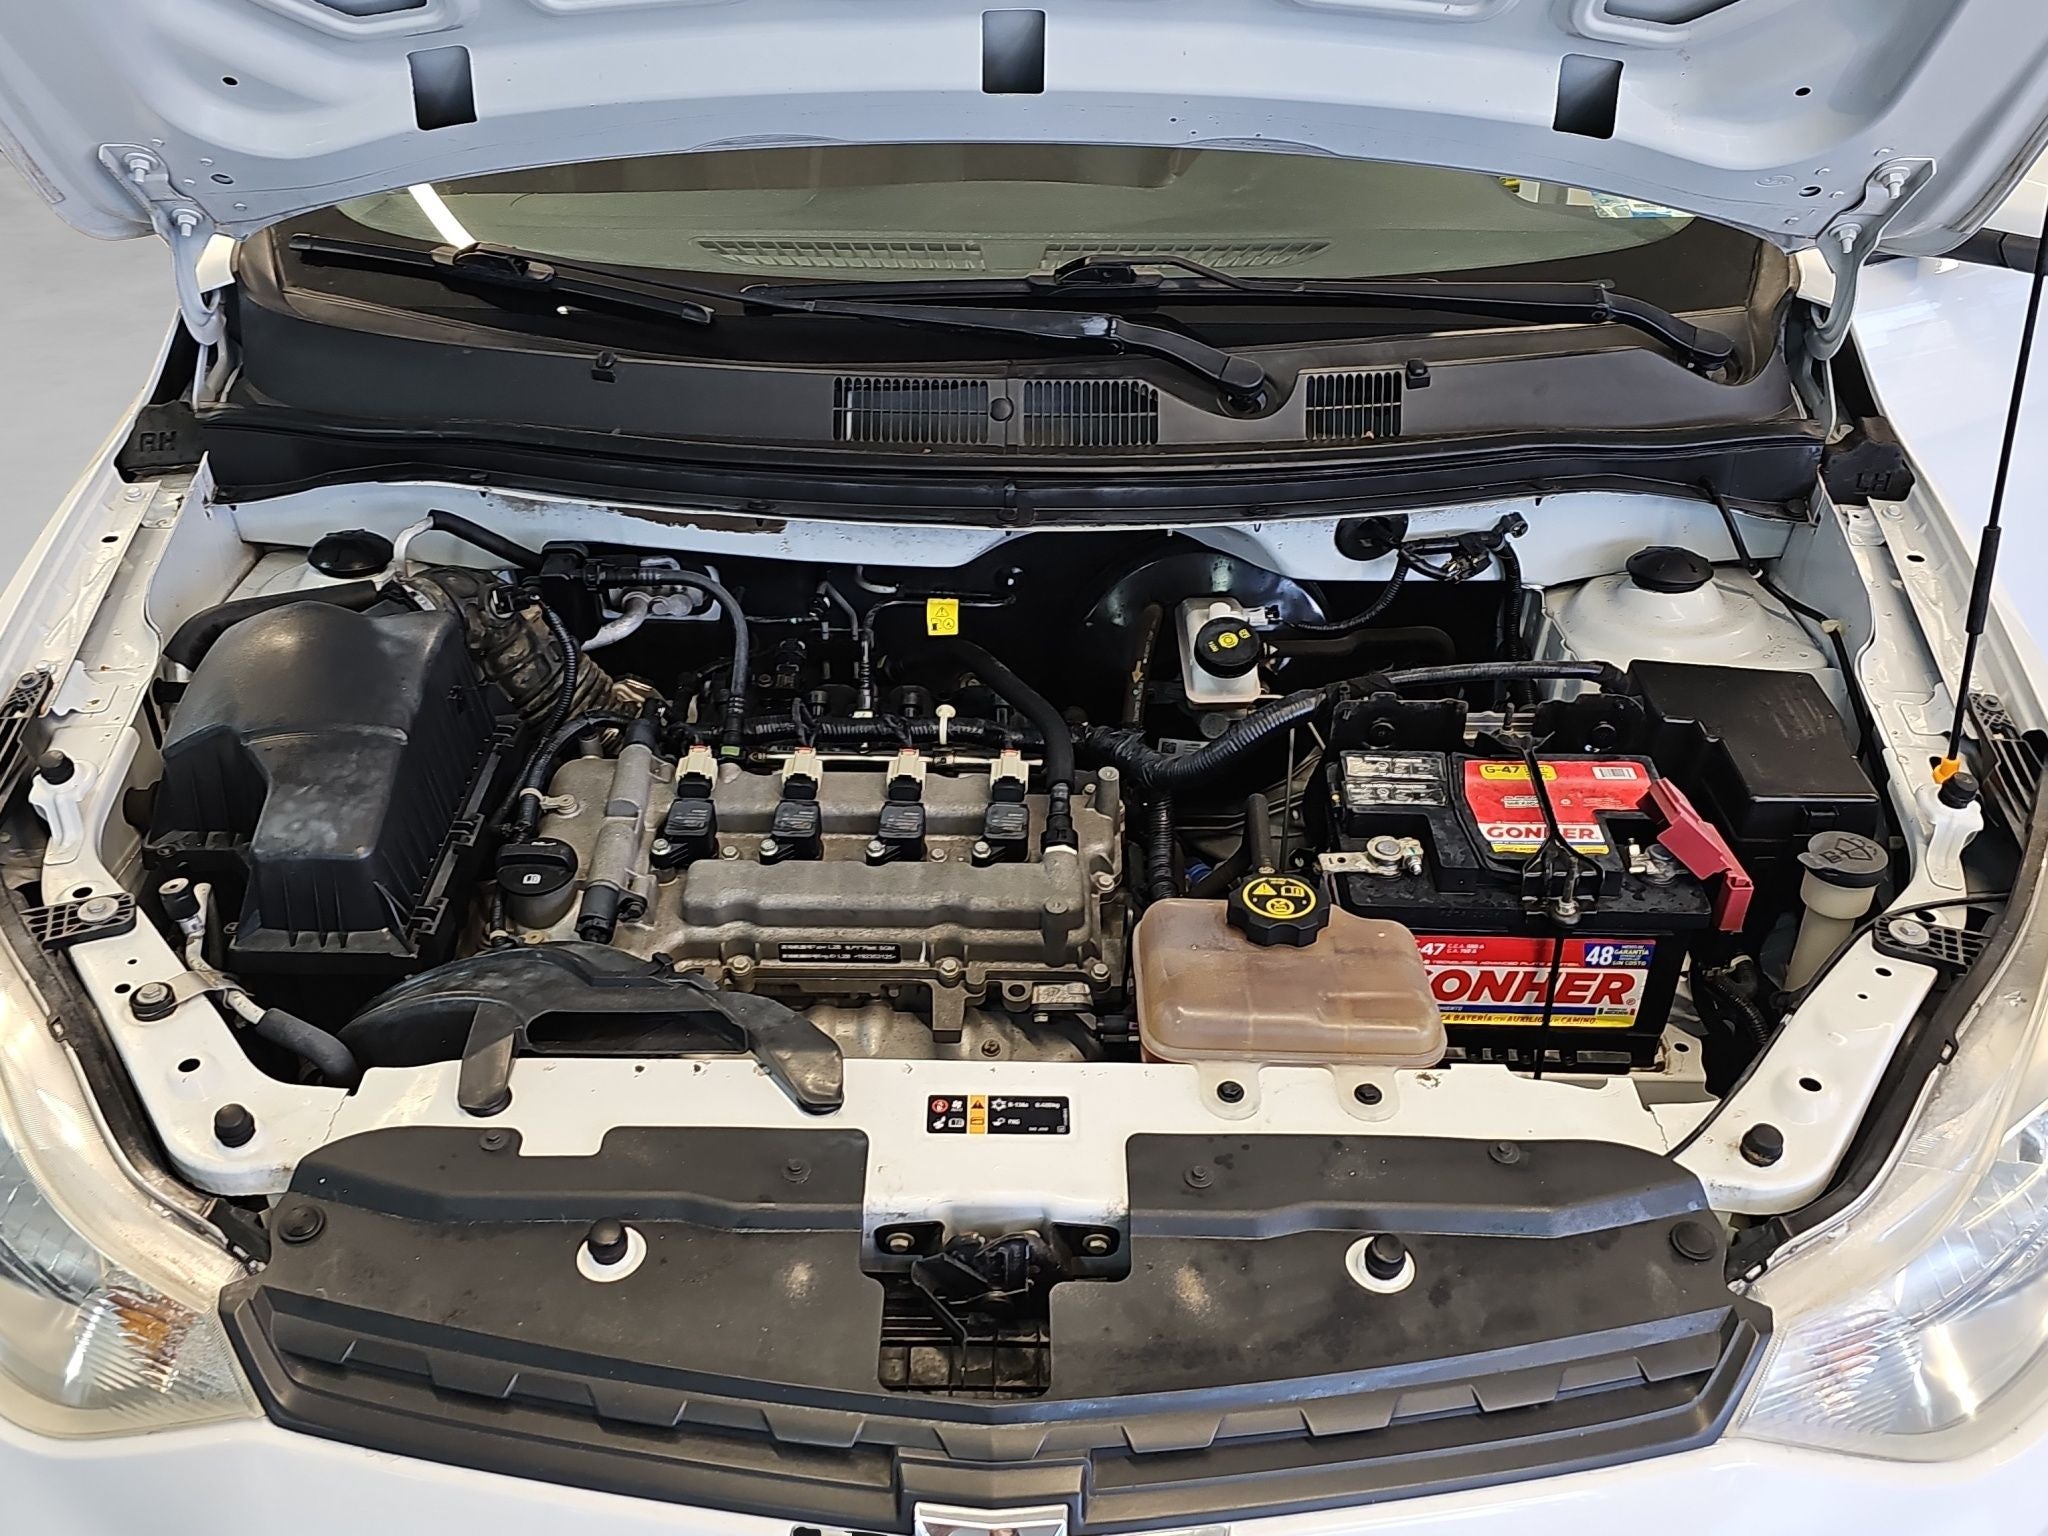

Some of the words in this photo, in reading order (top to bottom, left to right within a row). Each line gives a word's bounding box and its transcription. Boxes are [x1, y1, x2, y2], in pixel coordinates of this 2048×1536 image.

[139, 431, 177, 452] RH
[1855, 471, 1891, 493] LH
[1484, 765, 1520, 775] G-47
[1486, 827, 1595, 840] GONER
[1416, 942, 1446, 956] -47
[1586, 945, 1614, 966] 48
[1428, 969, 1635, 1005] ONHER
